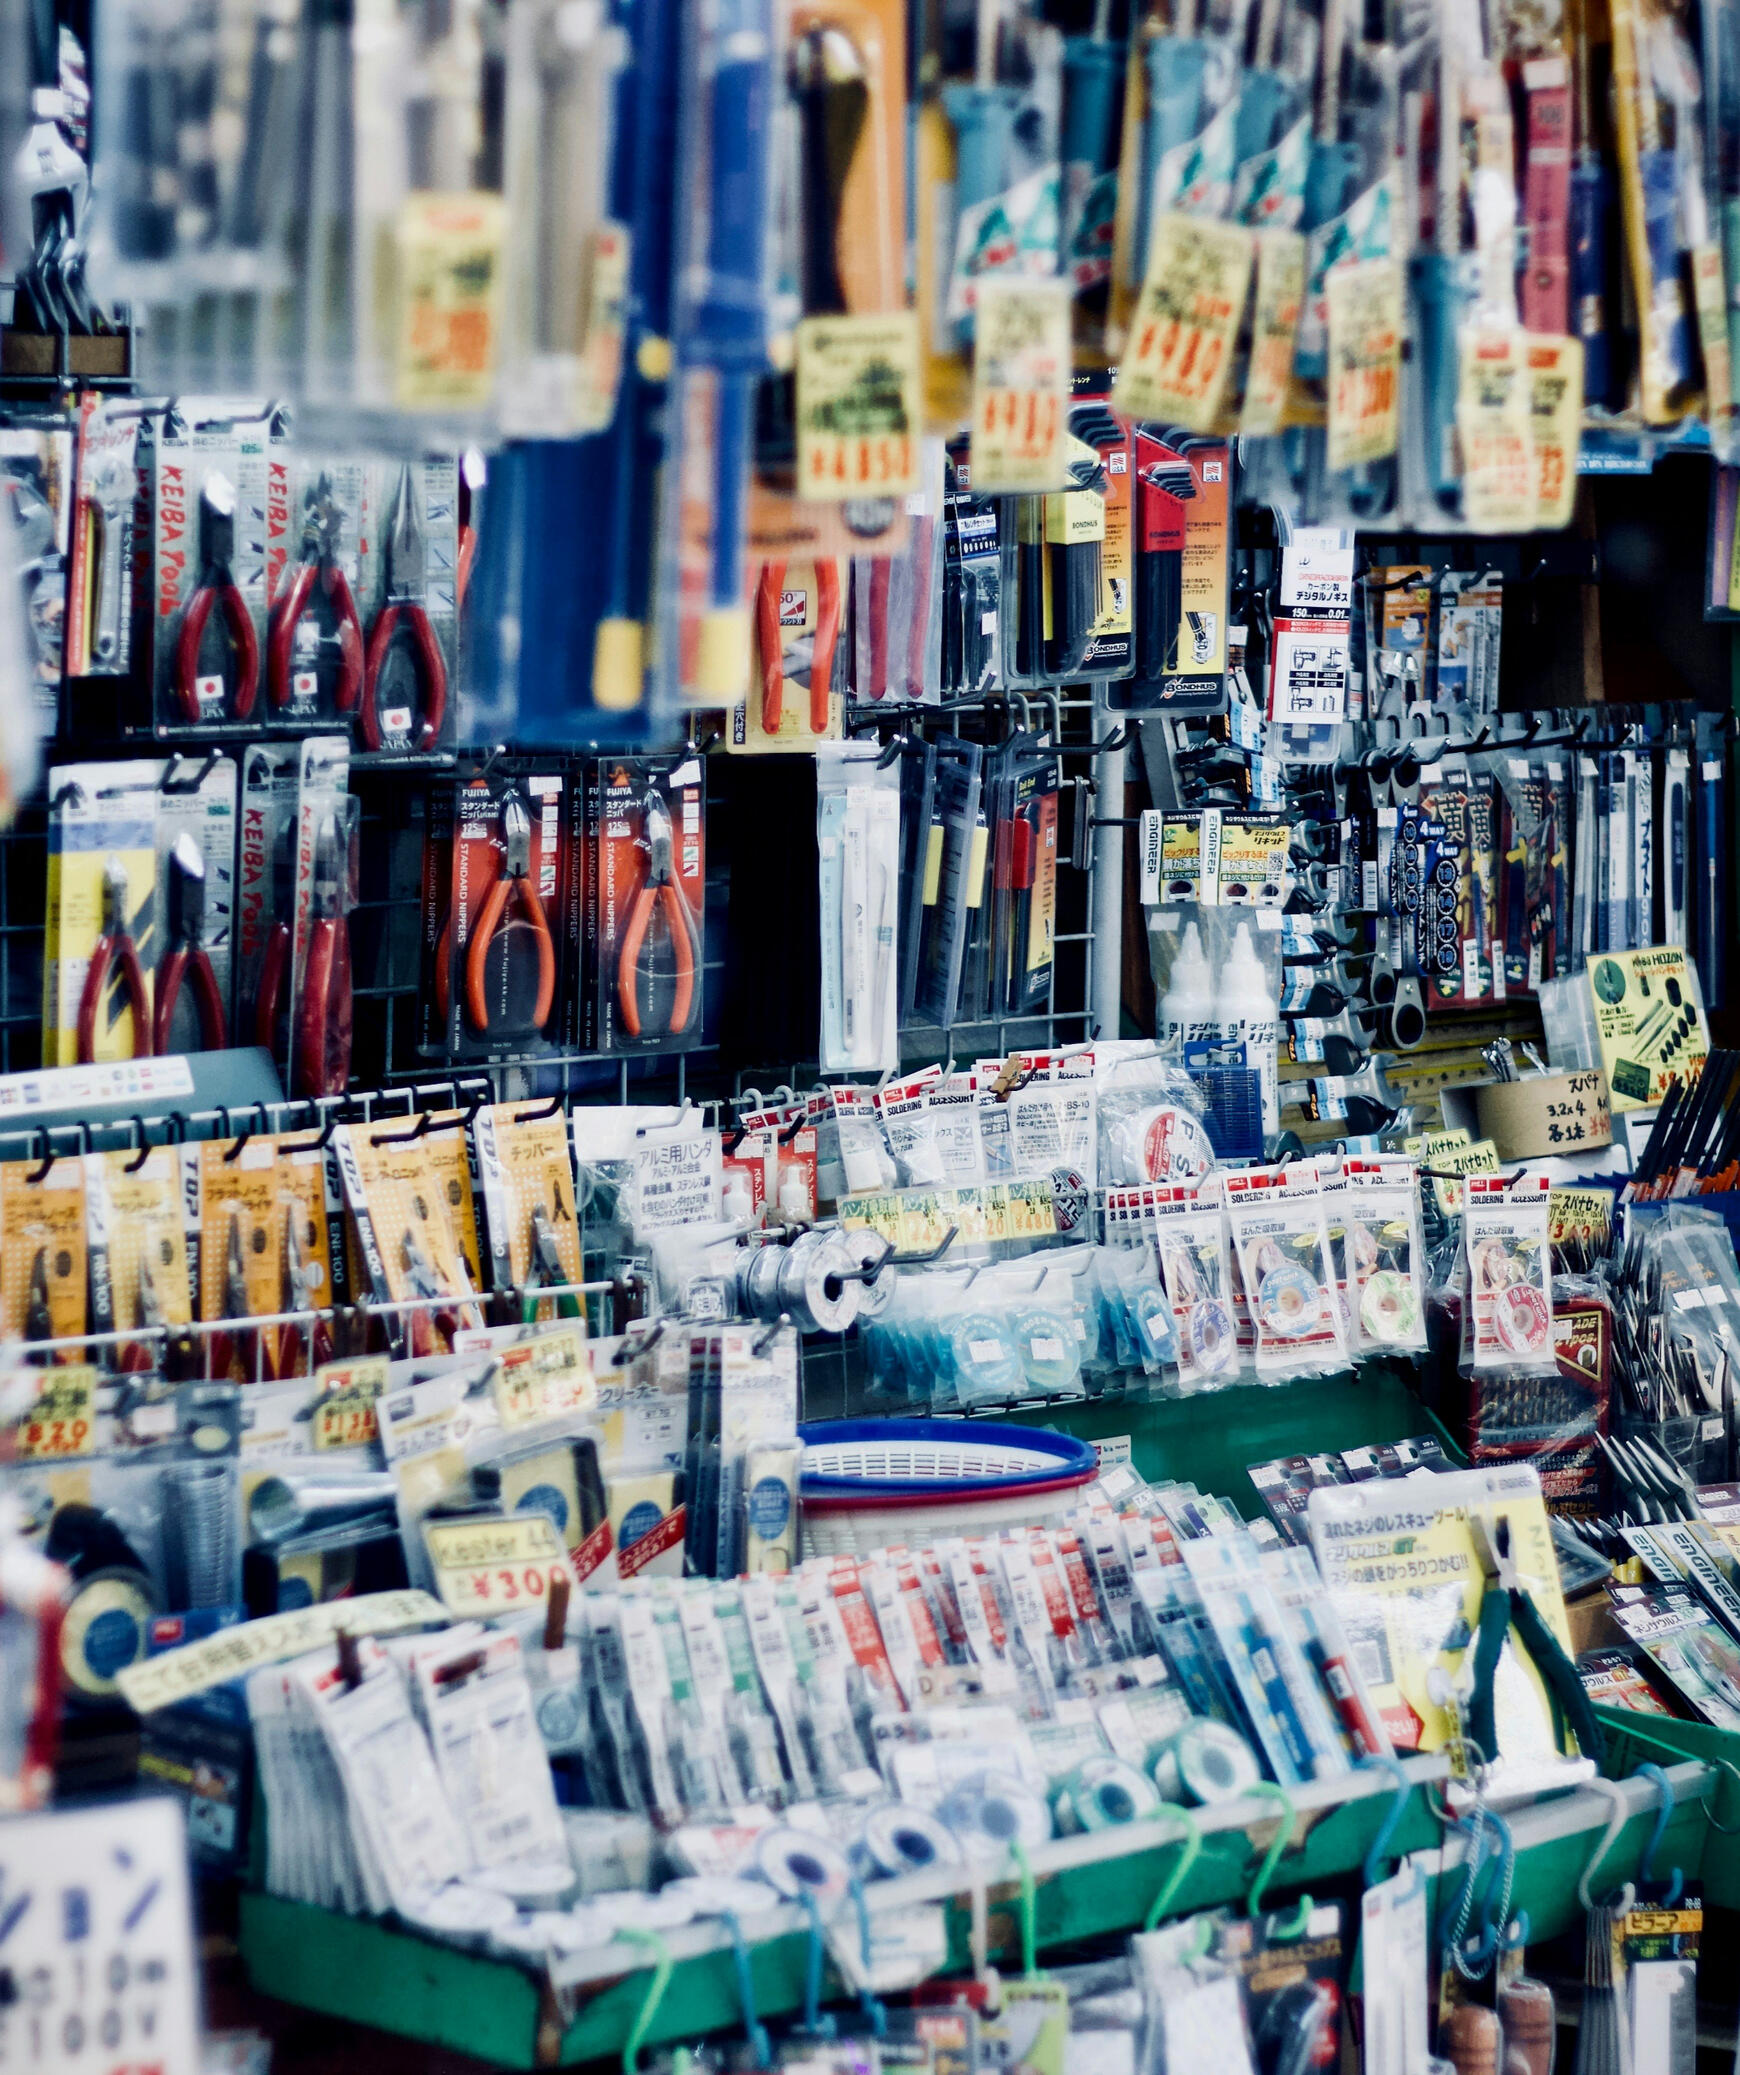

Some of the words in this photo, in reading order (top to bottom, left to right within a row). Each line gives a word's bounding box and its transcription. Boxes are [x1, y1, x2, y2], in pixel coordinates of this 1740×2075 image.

[160, 465, 186, 543] KEIBA
[268, 462, 288, 538] KEIBA
[1072, 520, 1098, 529] BONDHUS
[159, 550, 186, 617] TOOL
[1307, 583, 1340, 591] カーボン製
[1296, 591, 1349, 602] デジタルノギス
[1087, 642, 1128, 654] BONDHUS
[1166, 680, 1217, 693] BONDHUS
[462, 788, 491, 797] FUJIYA
[606, 787, 633, 796] FUJIYA
[461, 801, 500, 811] スタンダード
[606, 800, 642, 810] スタンダード
[606, 810, 624, 818] ニッパ
[1419, 820, 1447, 837] 4WAY
[243, 808, 265, 886] KEIBA
[299, 805, 313, 882] KEIBA
[1147, 815, 1159, 874] ENGINEER
[1206, 815, 1218, 875] ENGINEER
[1436, 842, 1460, 857] 4WAY
[1222, 850, 1268, 859] ビックリするほど
[459, 843, 469, 899] STANDARD
[607, 842, 615, 898] STANDARD
[457, 901, 468, 943] NIPPERS
[606, 900, 616, 942] NIPPERS
[1417, 865, 1426, 964] ラチェットレンチ
[1441, 924, 1453, 936] 17
[1652, 951, 1684, 965] HOZAN
[1568, 1074, 1599, 1093] スパナ
[887, 1101, 922, 1117] SOLDERING
[929, 1093, 975, 1107] ACCESSORY
[640, 1139, 712, 1168] アルミ用ハンダ
[1426, 1136, 1467, 1157] スパナセット
[1453, 1149, 1494, 1174] スパナセット
[186, 1157, 198, 1218] TOP
[1231, 1192, 1271, 1204] SOLDERING
[1471, 1194, 1504, 1205] SOLDERING
[1511, 1193, 1547, 1203] ACCESSORY
[1158, 1203, 1186, 1214] SOLDERING
[1015, 1211, 1052, 1232] ¥480
[330, 1221, 344, 1283] ENI-100
[1634, 1615, 1682, 1635] ネジザウルス
[1631, 1912, 1679, 1932] ピラニア
